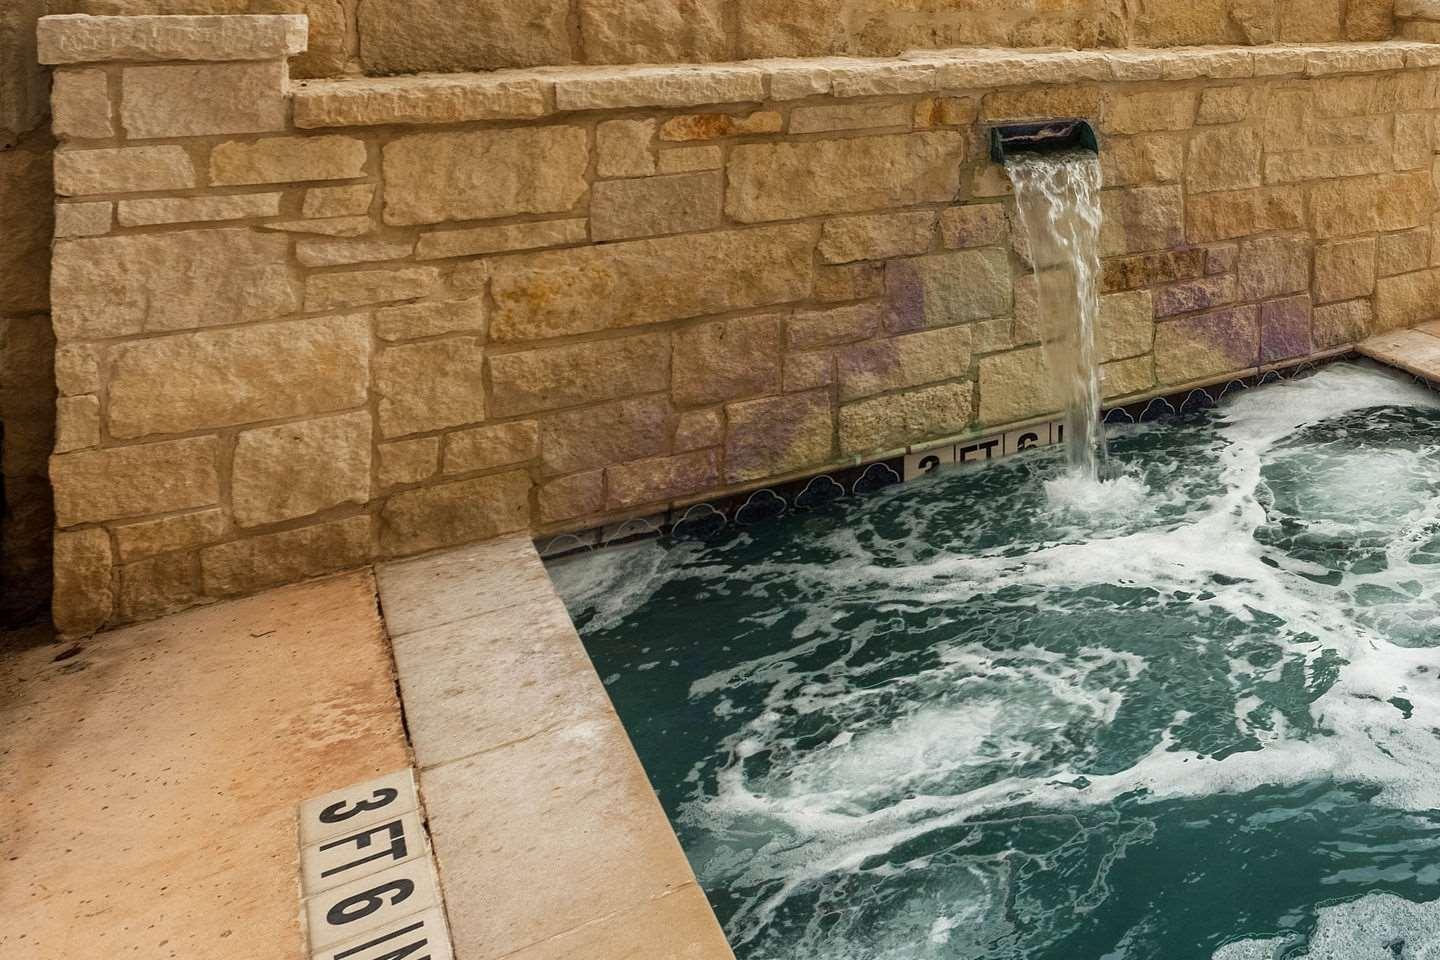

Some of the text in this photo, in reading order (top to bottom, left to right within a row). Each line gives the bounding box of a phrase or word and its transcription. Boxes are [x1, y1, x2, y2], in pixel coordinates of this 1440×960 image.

[959, 439, 999, 465] FT
[319, 787, 399, 823] 3
[318, 818, 409, 879] FT
[325, 877, 416, 926] 6
